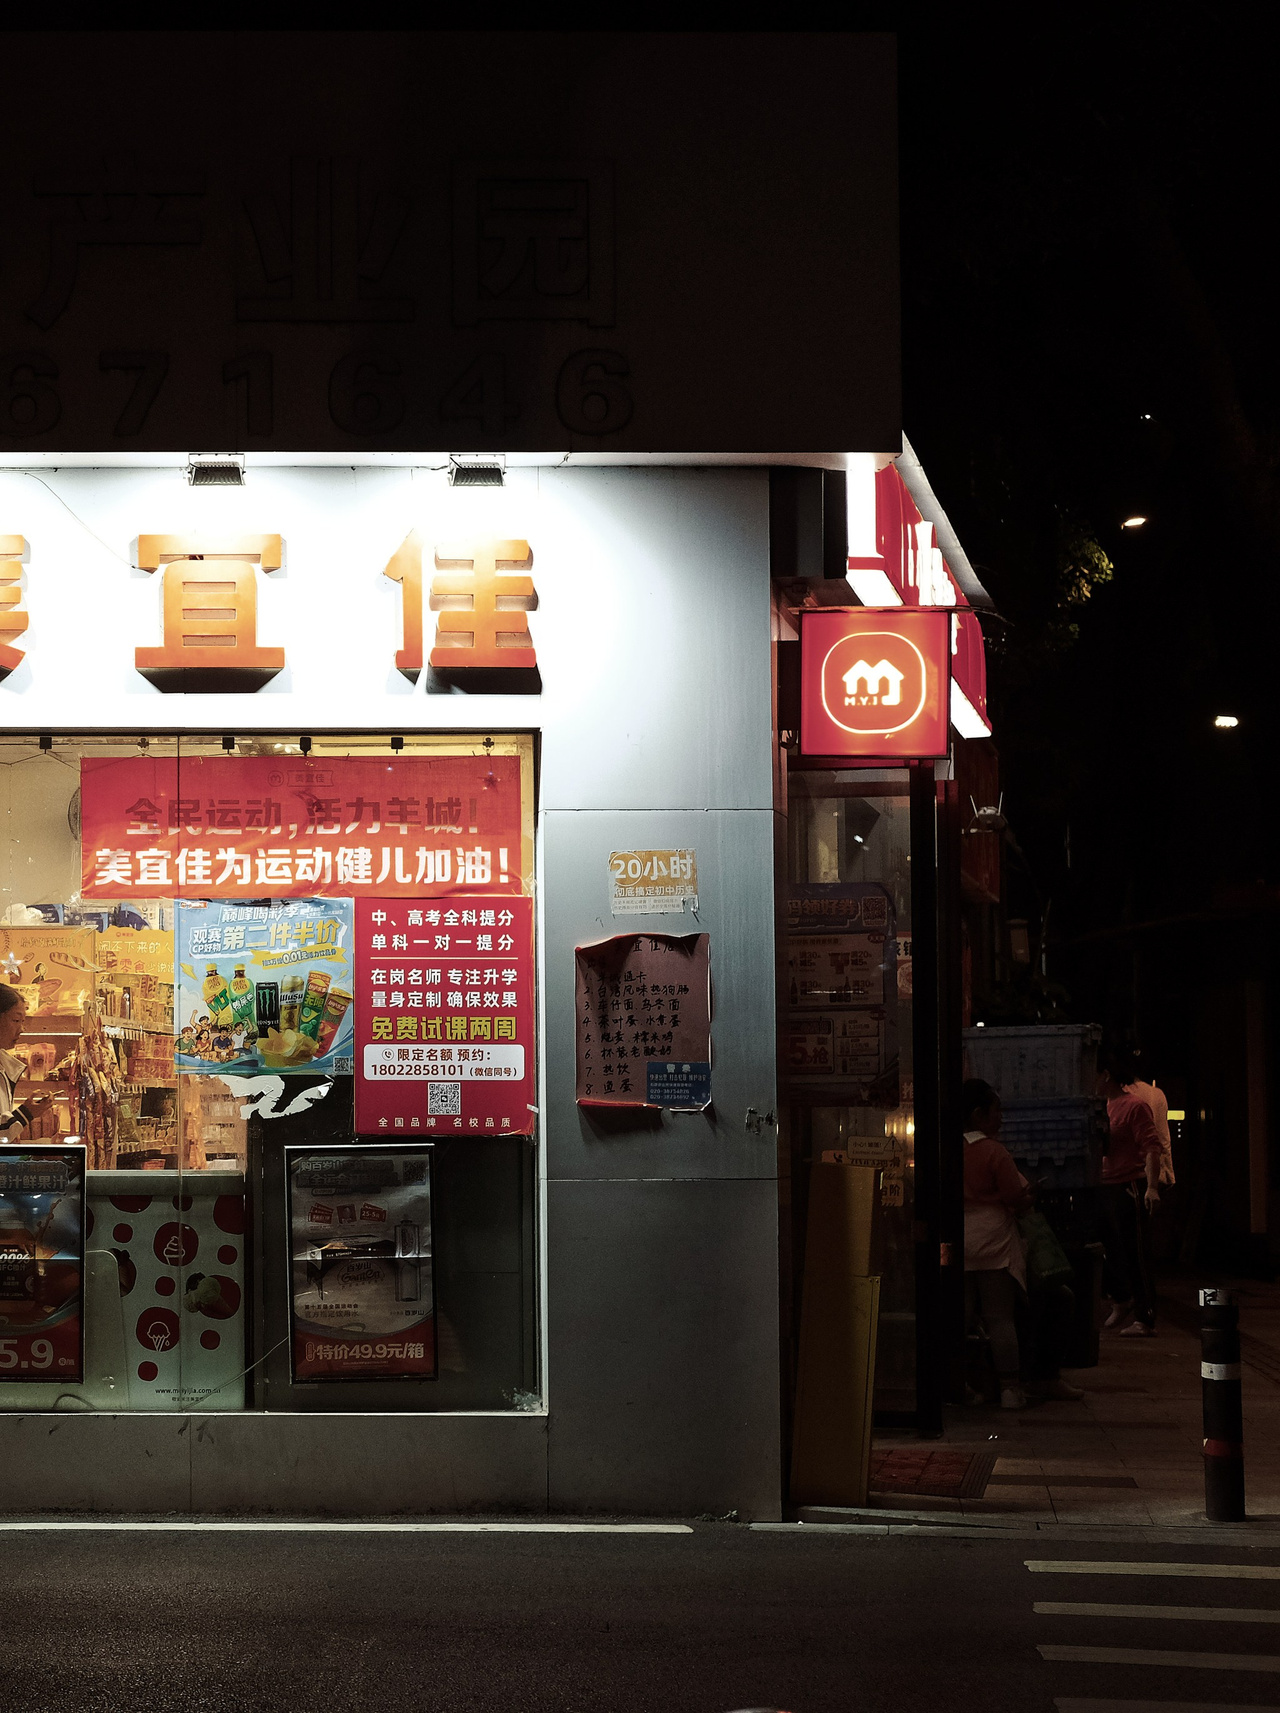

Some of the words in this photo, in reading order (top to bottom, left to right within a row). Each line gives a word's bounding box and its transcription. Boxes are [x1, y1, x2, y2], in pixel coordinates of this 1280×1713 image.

[613, 856, 693, 881] 20小时
[221, 903, 300, 924] 巅峰喝彩季
[371, 909, 515, 928] 中、高考全科提分
[192, 928, 222, 944] 观赛
[222, 919, 341, 951] 第二件半价
[371, 934, 516, 951] 单科一对一提分
[371, 967, 442, 985] 在岗名师
[447, 967, 518, 985] 专注升学
[371, 990, 442, 1009] 量身定制
[447, 990, 518, 1009] 确保效果
[371, 1015, 518, 1041] 免费试课两周
[397, 1048, 453, 1062] 限定名额
[371, 1064, 465, 1077] 18022858101
[378, 1117, 437, 1128] 全国品牌
[453, 1117, 511, 1128] 名校品质
[316, 1342, 425, 1360] 特价49.9元/箱
